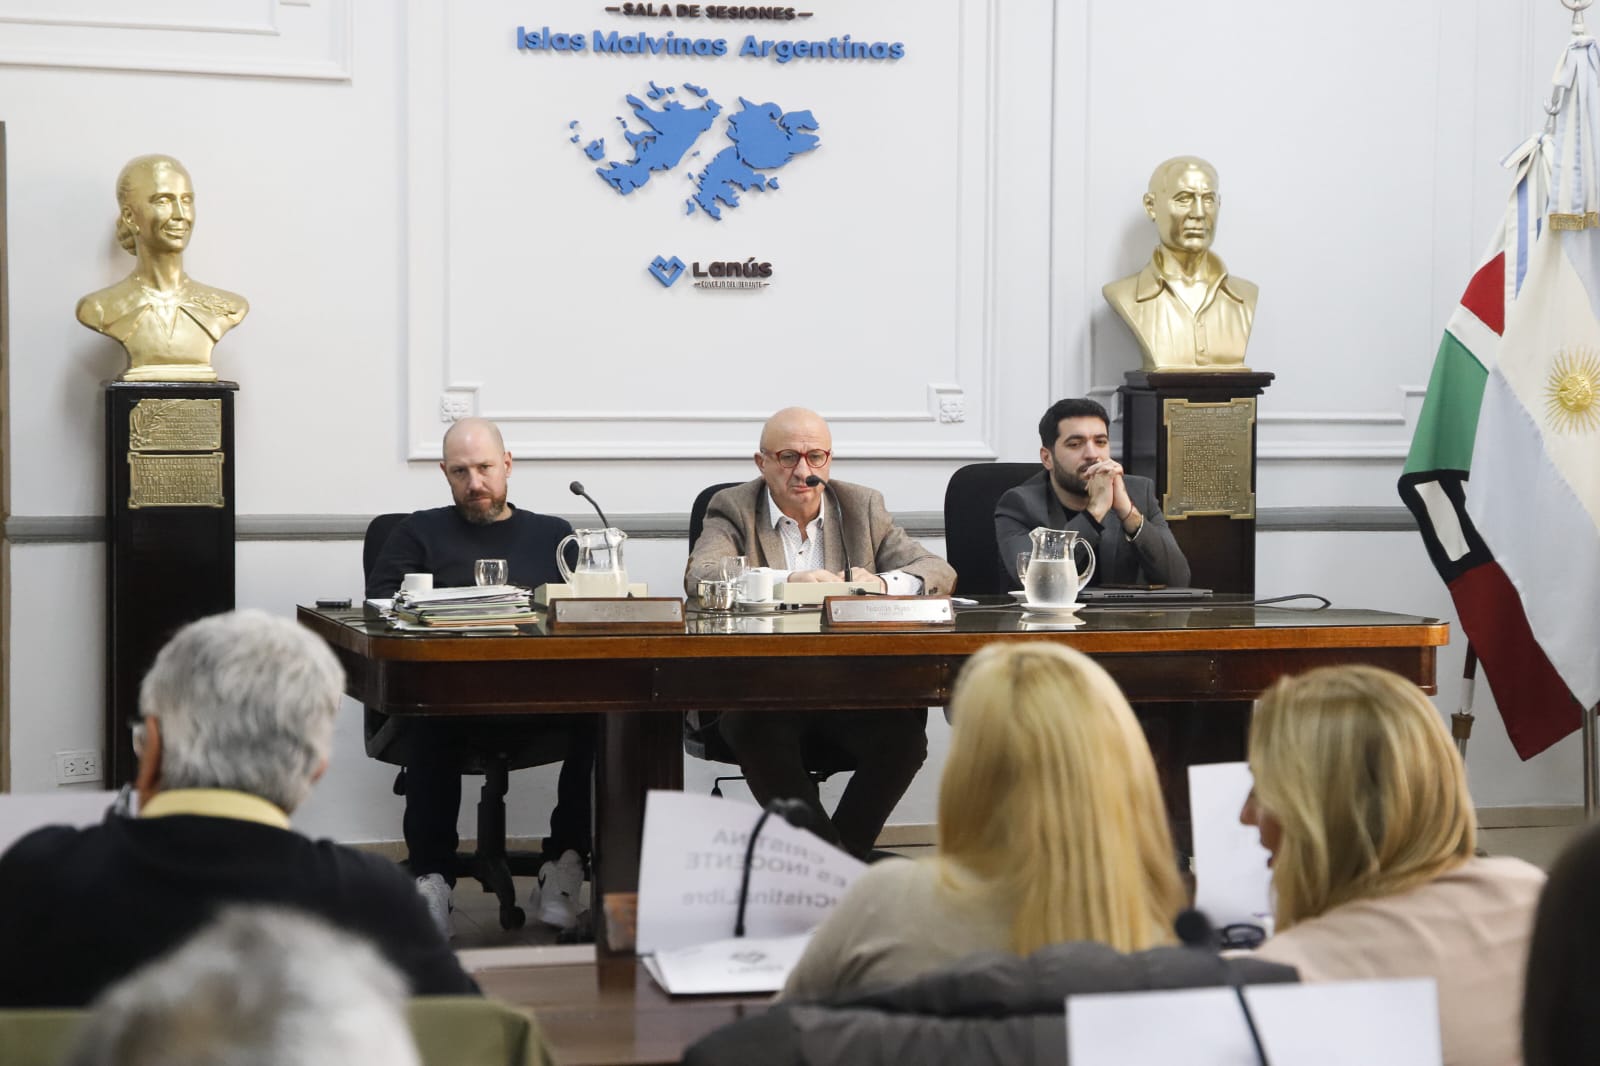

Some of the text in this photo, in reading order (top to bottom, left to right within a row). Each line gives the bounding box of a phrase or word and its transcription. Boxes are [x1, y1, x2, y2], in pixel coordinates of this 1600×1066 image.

[622, 2, 796, 20] SALA DE SESIONES
[516, 26, 905, 63] Islas Malvinas Argentinas
[692, 257, 773, 278] Lanús
